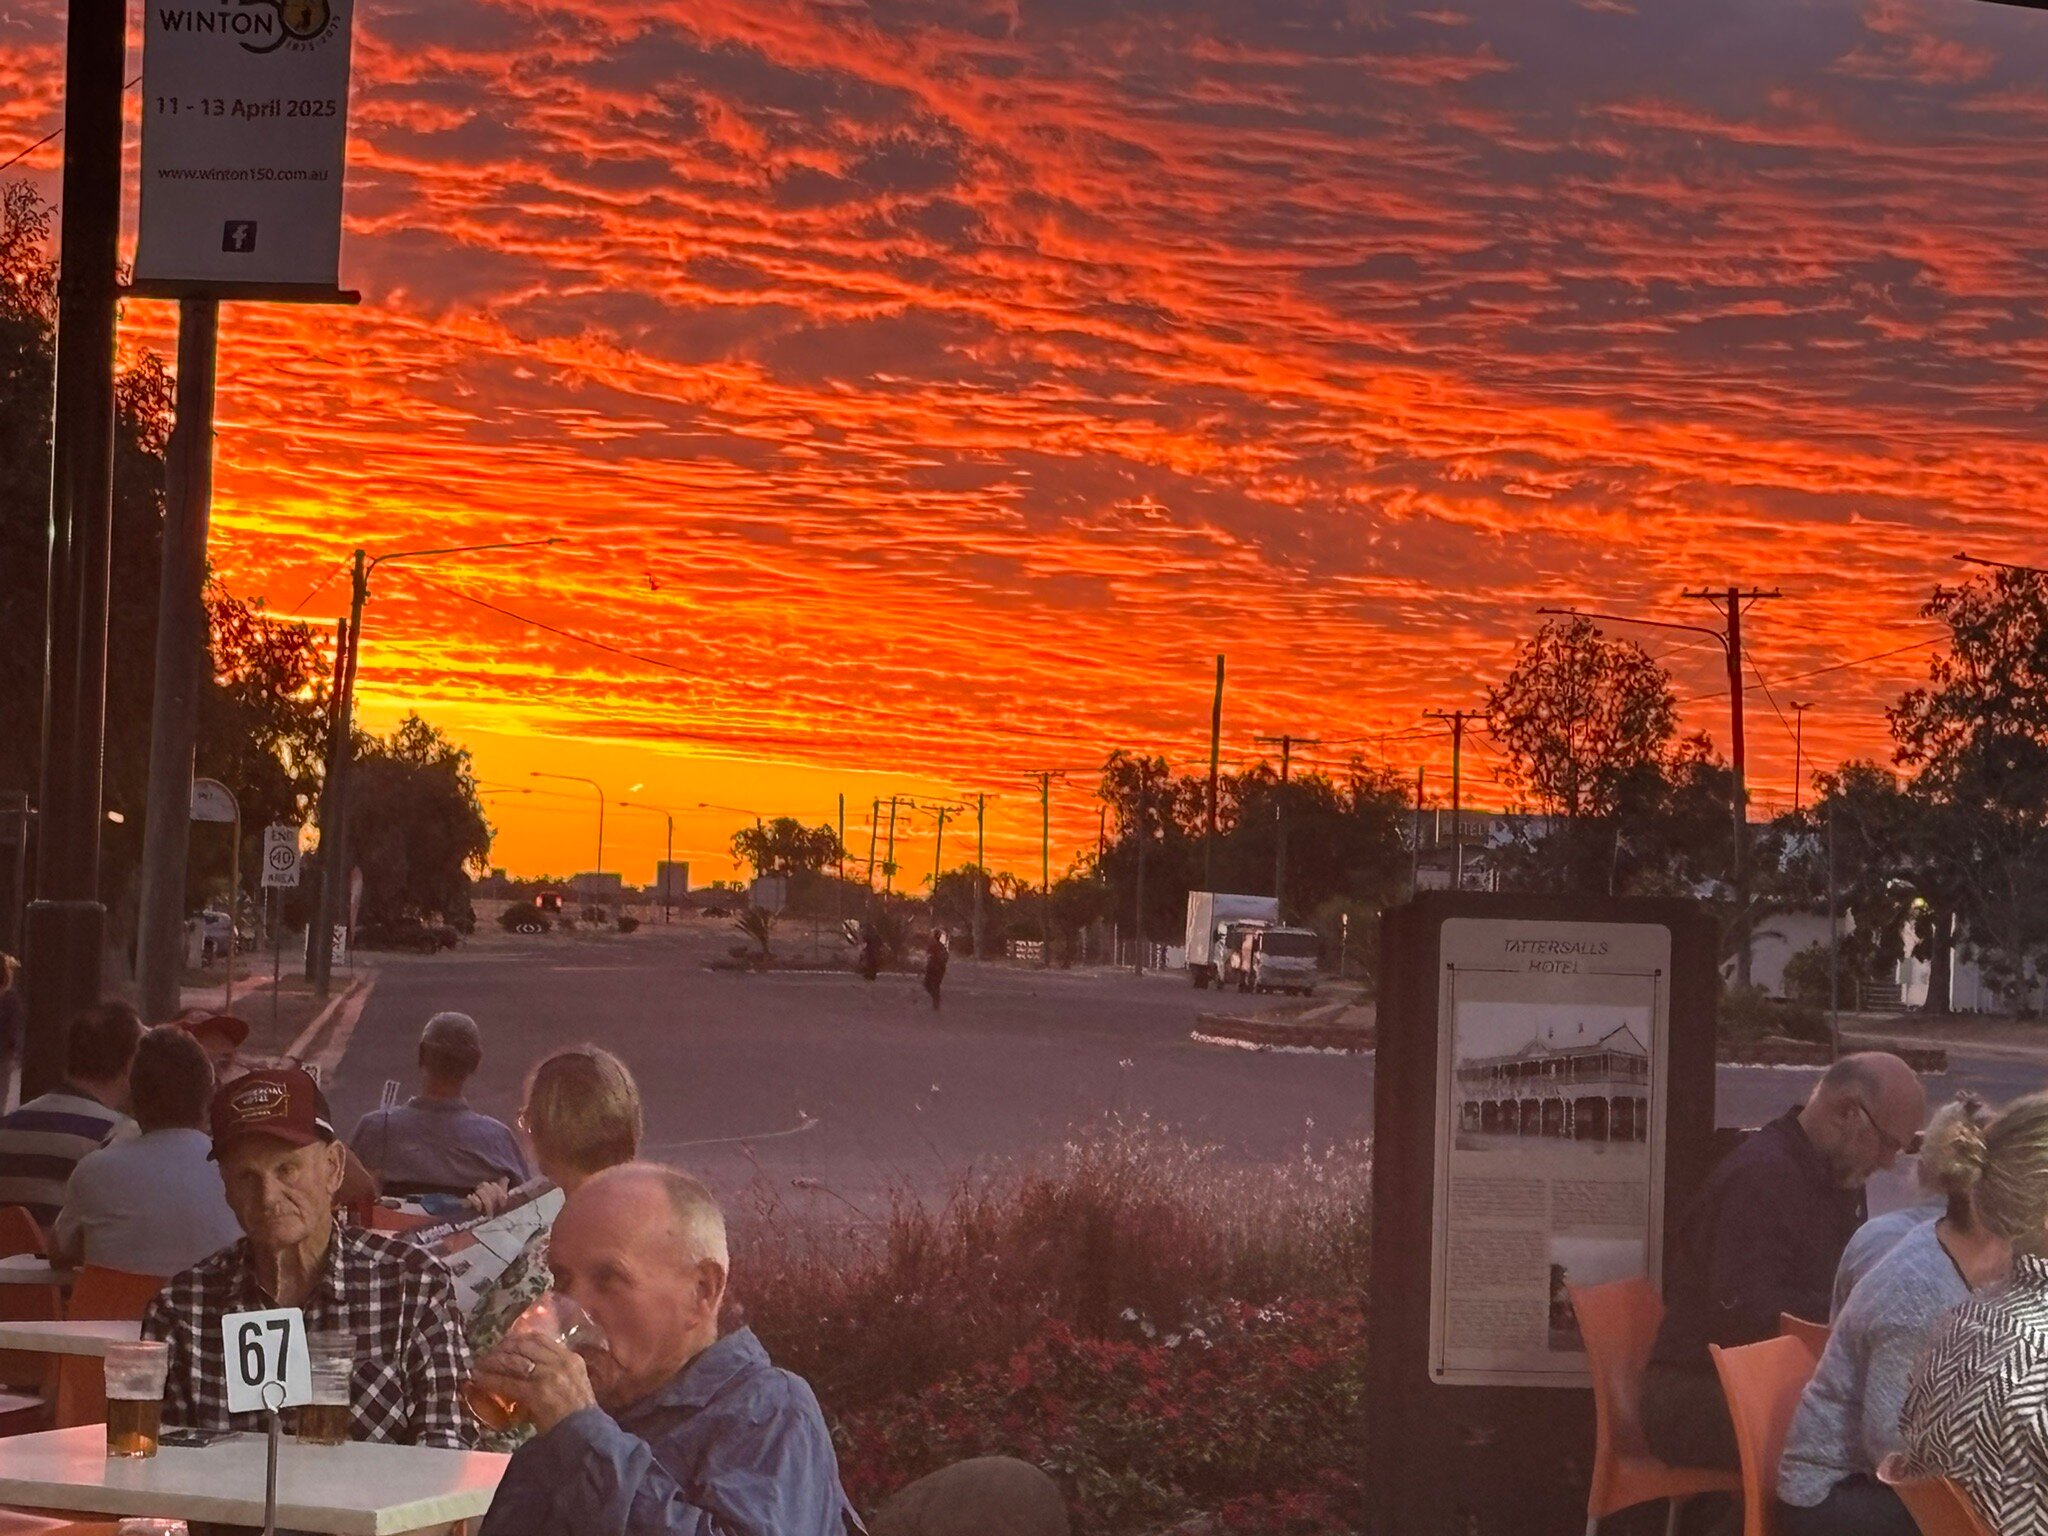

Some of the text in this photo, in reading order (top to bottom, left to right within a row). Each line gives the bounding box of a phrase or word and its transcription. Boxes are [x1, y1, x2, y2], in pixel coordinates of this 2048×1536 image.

[159, 9, 273, 36] WINTON
[157, 97, 178, 115] 11
[201, 98, 226, 117] 13
[231, 99, 281, 121] April
[286, 100, 337, 118] 2025
[158, 167, 329, 182] www.winton150.com.au
[271, 829, 294, 842] END
[272, 851, 291, 865] 40
[267, 874, 295, 884] AREA
[1504, 939, 1609, 955] TATTERSALLS
[1528, 960, 1580, 974] HOTEL
[238, 1319, 290, 1386] 67
